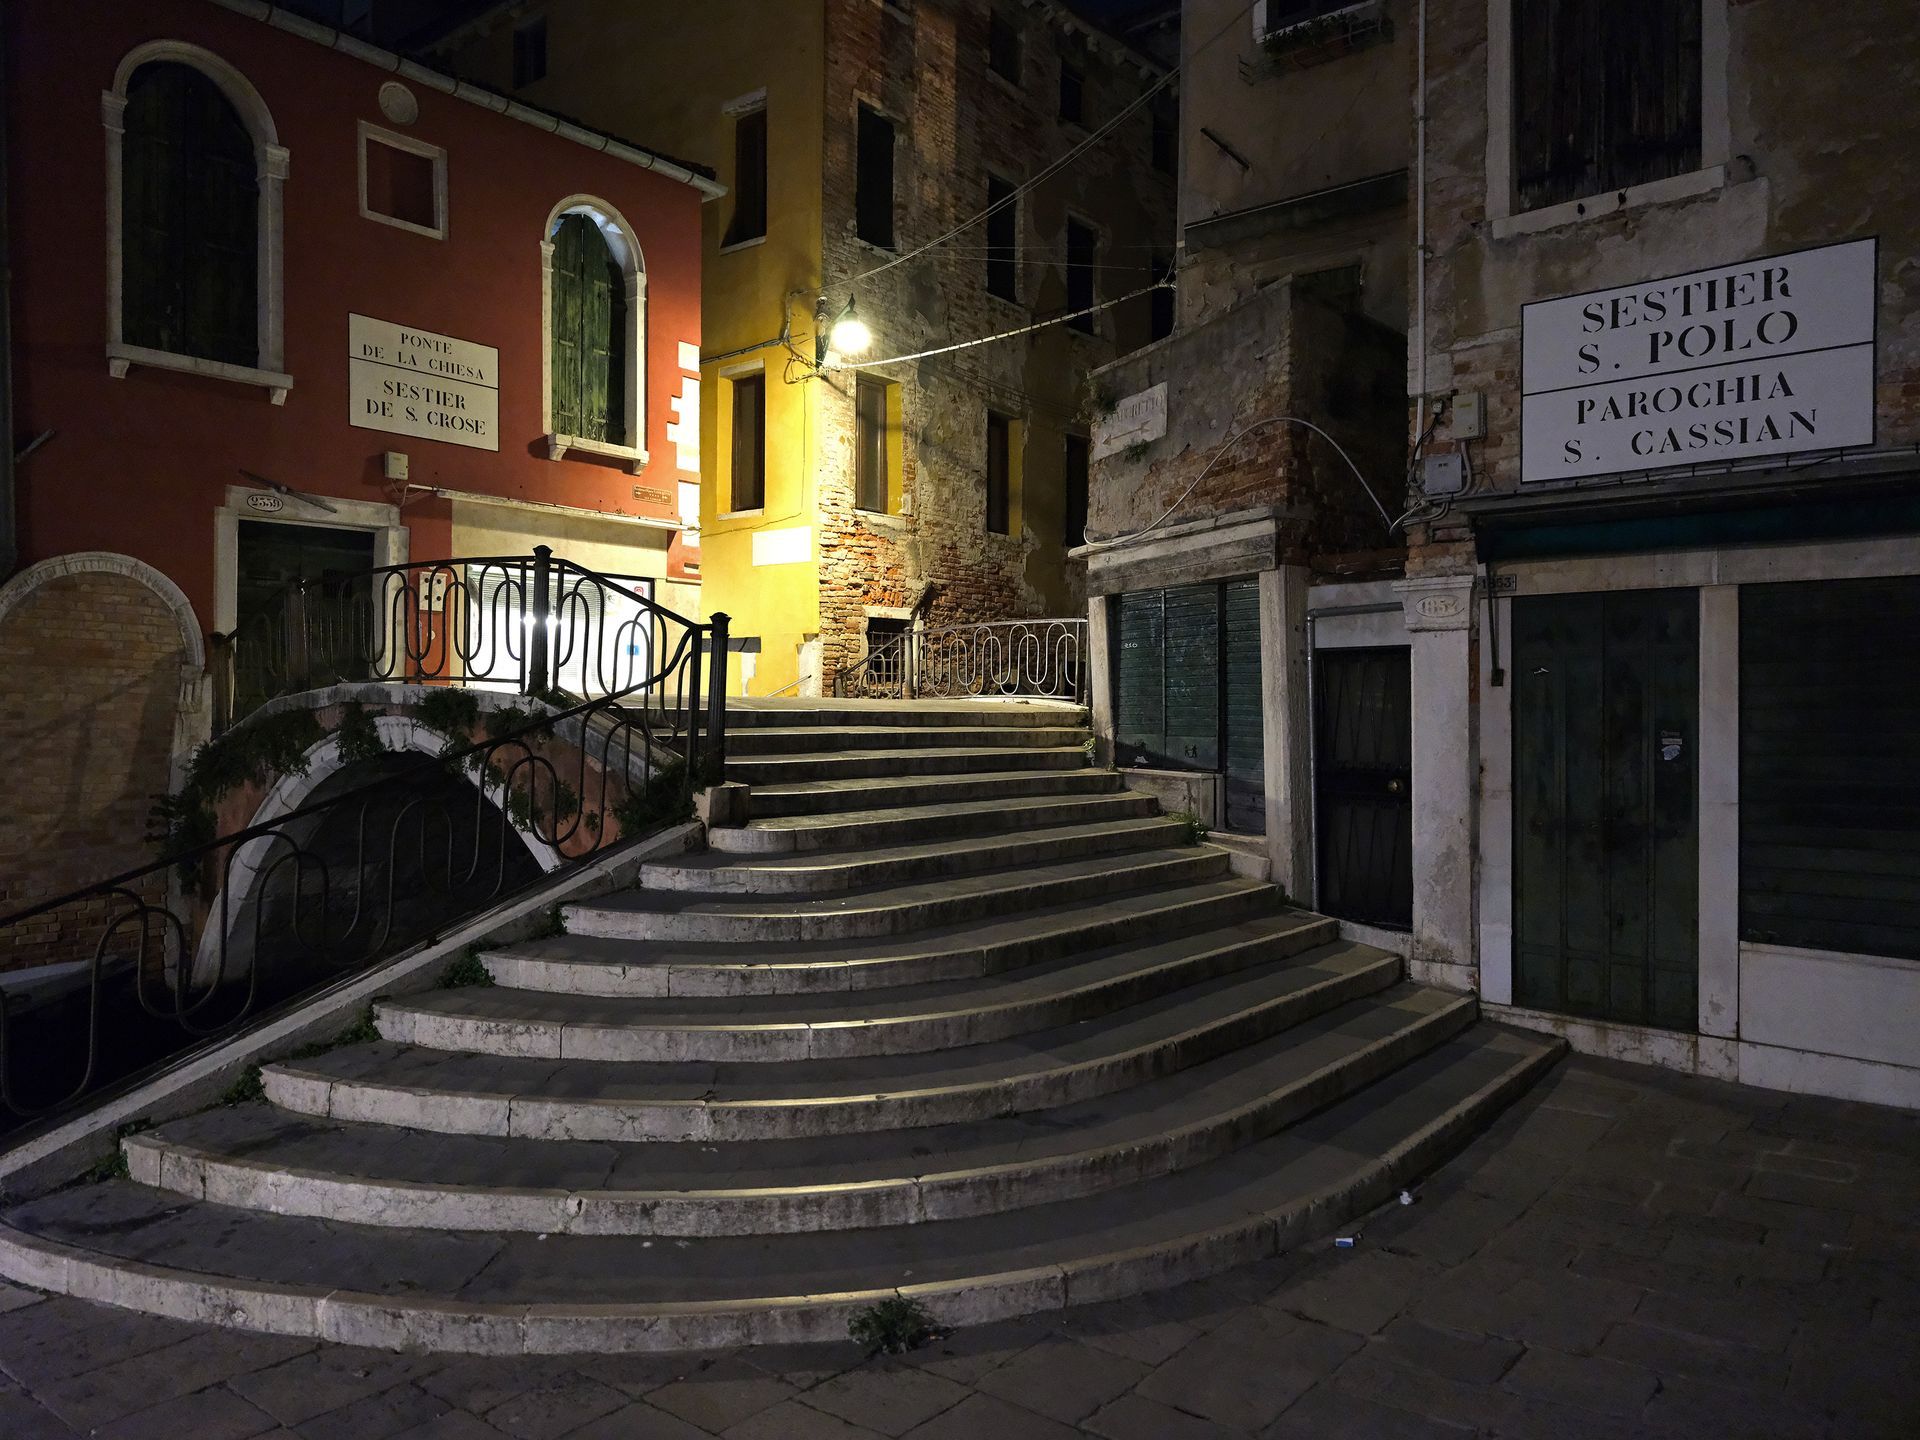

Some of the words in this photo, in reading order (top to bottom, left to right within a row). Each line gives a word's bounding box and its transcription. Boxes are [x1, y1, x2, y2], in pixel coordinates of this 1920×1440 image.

[1582, 267, 1792, 334] SESTIER
[363, 344, 384, 359] DE
[398, 351, 417, 366] LA
[429, 358, 484, 380] CHIESA
[401, 333, 452, 355] PONTE
[1578, 343, 1620, 374] S.
[1649, 310, 1798, 364] POLO
[366, 398, 393, 418] DE
[405, 406, 418, 422] S.
[427, 411, 486, 435] CROSE
[383, 379, 466, 410] SESTIER
[1577, 371, 1794, 425] PAROCHIA
[1564, 439, 1600, 464] S.
[1631, 409, 1817, 455] CASSIAN
